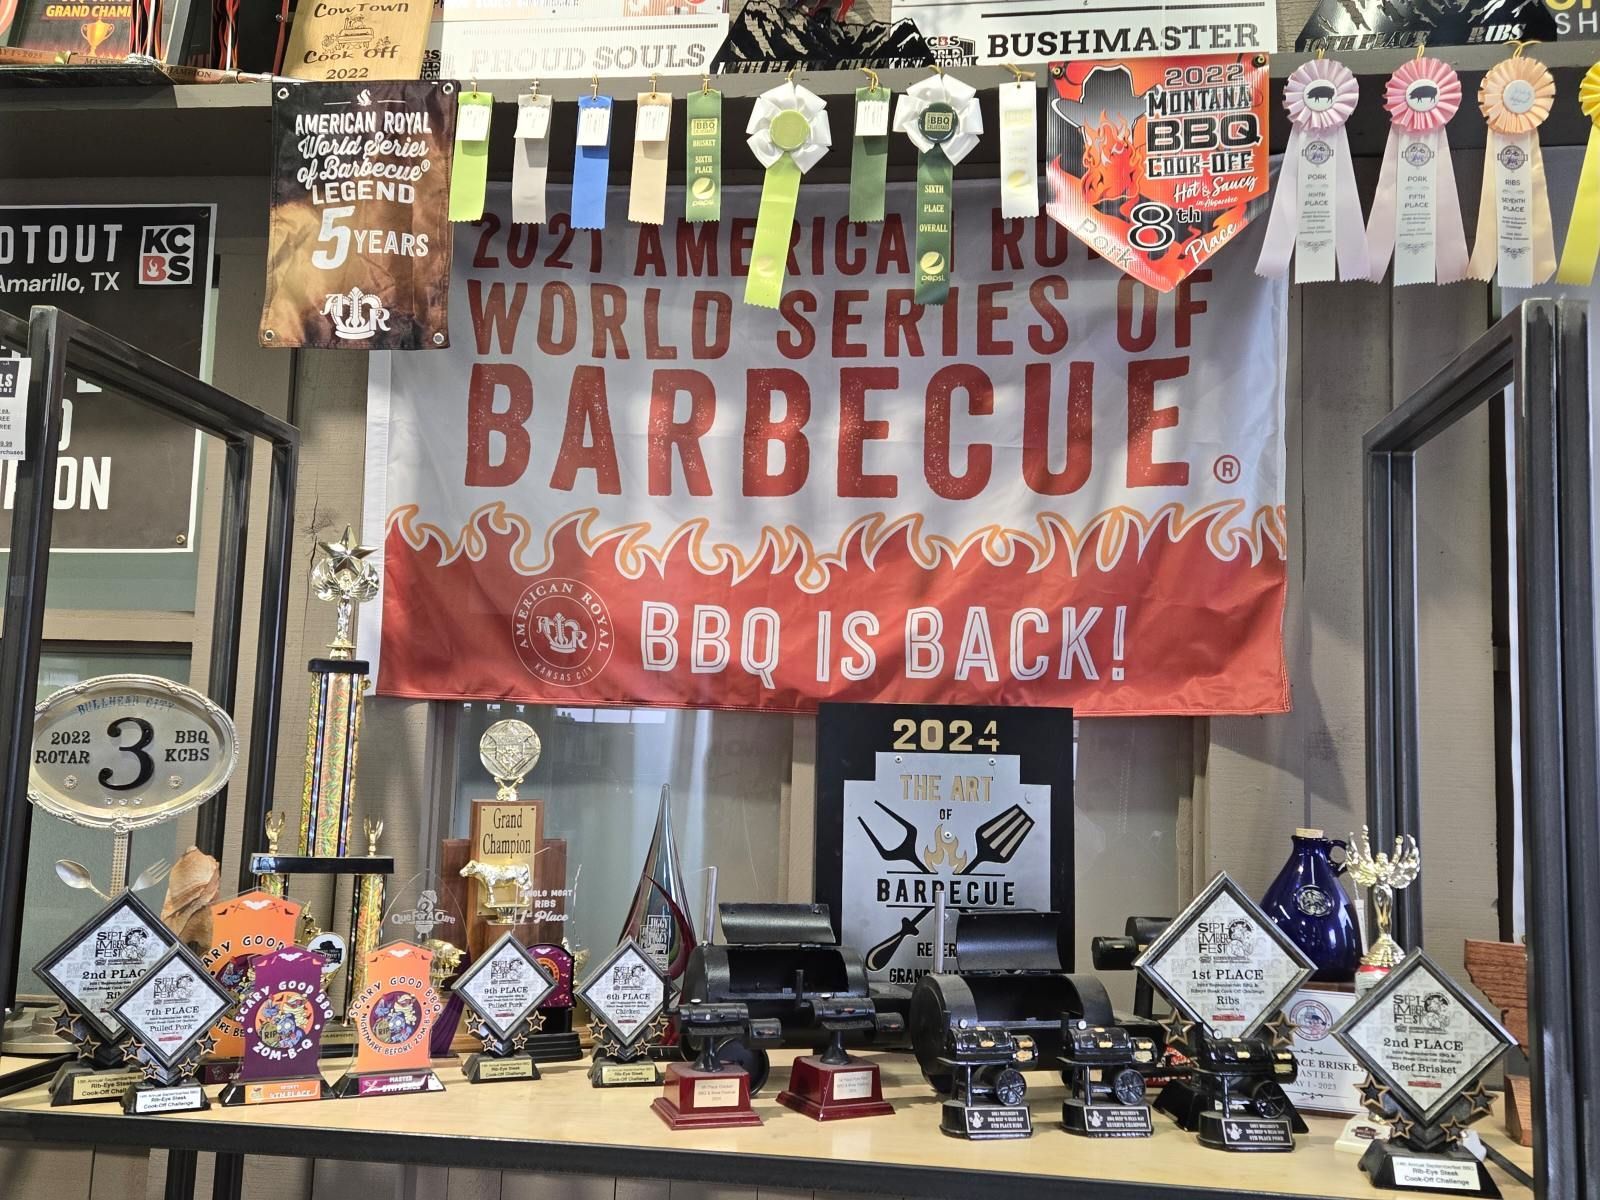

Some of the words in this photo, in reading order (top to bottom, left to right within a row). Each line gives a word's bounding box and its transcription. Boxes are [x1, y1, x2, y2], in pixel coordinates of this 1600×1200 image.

[46, 5, 82, 18] GRAND
[987, 23, 1260, 58] BUSHMASTER
[1467, 23, 1526, 42] RIBS
[304, 50, 354, 64] Cook
[364, 45, 400, 59] Off
[595, 43, 707, 70] SOULS
[326, 68, 369, 80] 2022
[1165, 64, 1245, 87] 2022
[1146, 86, 1252, 117] MONTANA
[295, 112, 376, 136] AMERICAN
[384, 112, 432, 134] ROYAL
[1146, 114, 1261, 153] BBQ
[297, 135, 363, 159] World
[363, 131, 429, 159] Series
[695, 155, 713, 164] SIXTH
[1146, 151, 1254, 179] COOK-OFF
[297, 159, 318, 190] of
[694, 165, 713, 174] PLACE
[1307, 173, 1327, 181] PORK
[1407, 175, 1428, 183] PORK
[312, 180, 415, 205] LEGEND
[924, 185, 944, 194] SIXTH
[1174, 183, 1201, 203] Hot
[1212, 176, 1258, 197] Saucy
[1505, 179, 1521, 187] RIBS
[924, 204, 944, 213] PLACE
[312, 206, 355, 269] 5
[354, 230, 429, 257] YEARS
[919, 224, 948, 233] OVERALL
[472, 213, 602, 272] 2021
[1077, 217, 1135, 268] Pork
[1184, 223, 1237, 264] Place
[90, 271, 120, 292] TX
[467, 279, 732, 360] WORLD
[776, 274, 1069, 358] SERIES
[1117, 268, 1213, 353] OF
[464, 356, 1190, 500] BARBECUE
[516, 583, 574, 649] AMERICAN
[582, 592, 610, 652] ROYAL
[641, 600, 782, 690] BBQ
[816, 609, 880, 682] IS
[904, 605, 1127, 681] BACK!
[534, 663, 571, 681] KANSAS
[51, 731, 90, 745] 2022
[175, 730, 210, 744] BBQ
[893, 719, 1000, 752] 2024
[35, 750, 90, 764] ROTAR
[165, 748, 209, 762] KCBS
[98, 716, 155, 791] 3
[900, 774, 941, 801] THE
[952, 775, 994, 802] ART
[493, 807, 523, 829] Grand
[939, 808, 953, 820] OF
[482, 833, 531, 858] Champion
[391, 913, 412, 925] Que
[435, 911, 456, 924] Cure
[534, 911, 569, 924] Place
[1199, 943, 1229, 954] FEST
[82, 970, 106, 980] 2nd
[110, 968, 147, 979] PLAC
[1192, 969, 1211, 980] 1st
[1216, 968, 1264, 980] PLACE
[350, 982, 381, 1017] SCARY
[390, 976, 422, 989] GOOD
[425, 989, 441, 1012] BBQ
[500, 986, 528, 994] PLACE
[236, 986, 270, 1022] SCARY
[278, 980, 314, 994] GOOD
[315, 993, 334, 1019] BBQ
[1217, 996, 1240, 1005] Ribs
[145, 1008, 161, 1016] 7th
[165, 1005, 199, 1015] PLACE
[150, 1024, 173, 1032] Pulled
[175, 1023, 193, 1031] Pork
[264, 1032, 277, 1040] RIP
[252, 1039, 313, 1061] ZOM-B-Q
[1383, 1037, 1409, 1048] 2nd
[1414, 1039, 1464, 1051] PLACE
[1300, 1070, 1335, 1080] ASTER
[1392, 1062, 1417, 1072] Beef
[1418, 1063, 1457, 1074] Brisket
[1404, 1175, 1434, 1183] Cook-Off
[1436, 1177, 1470, 1186] Challenge
